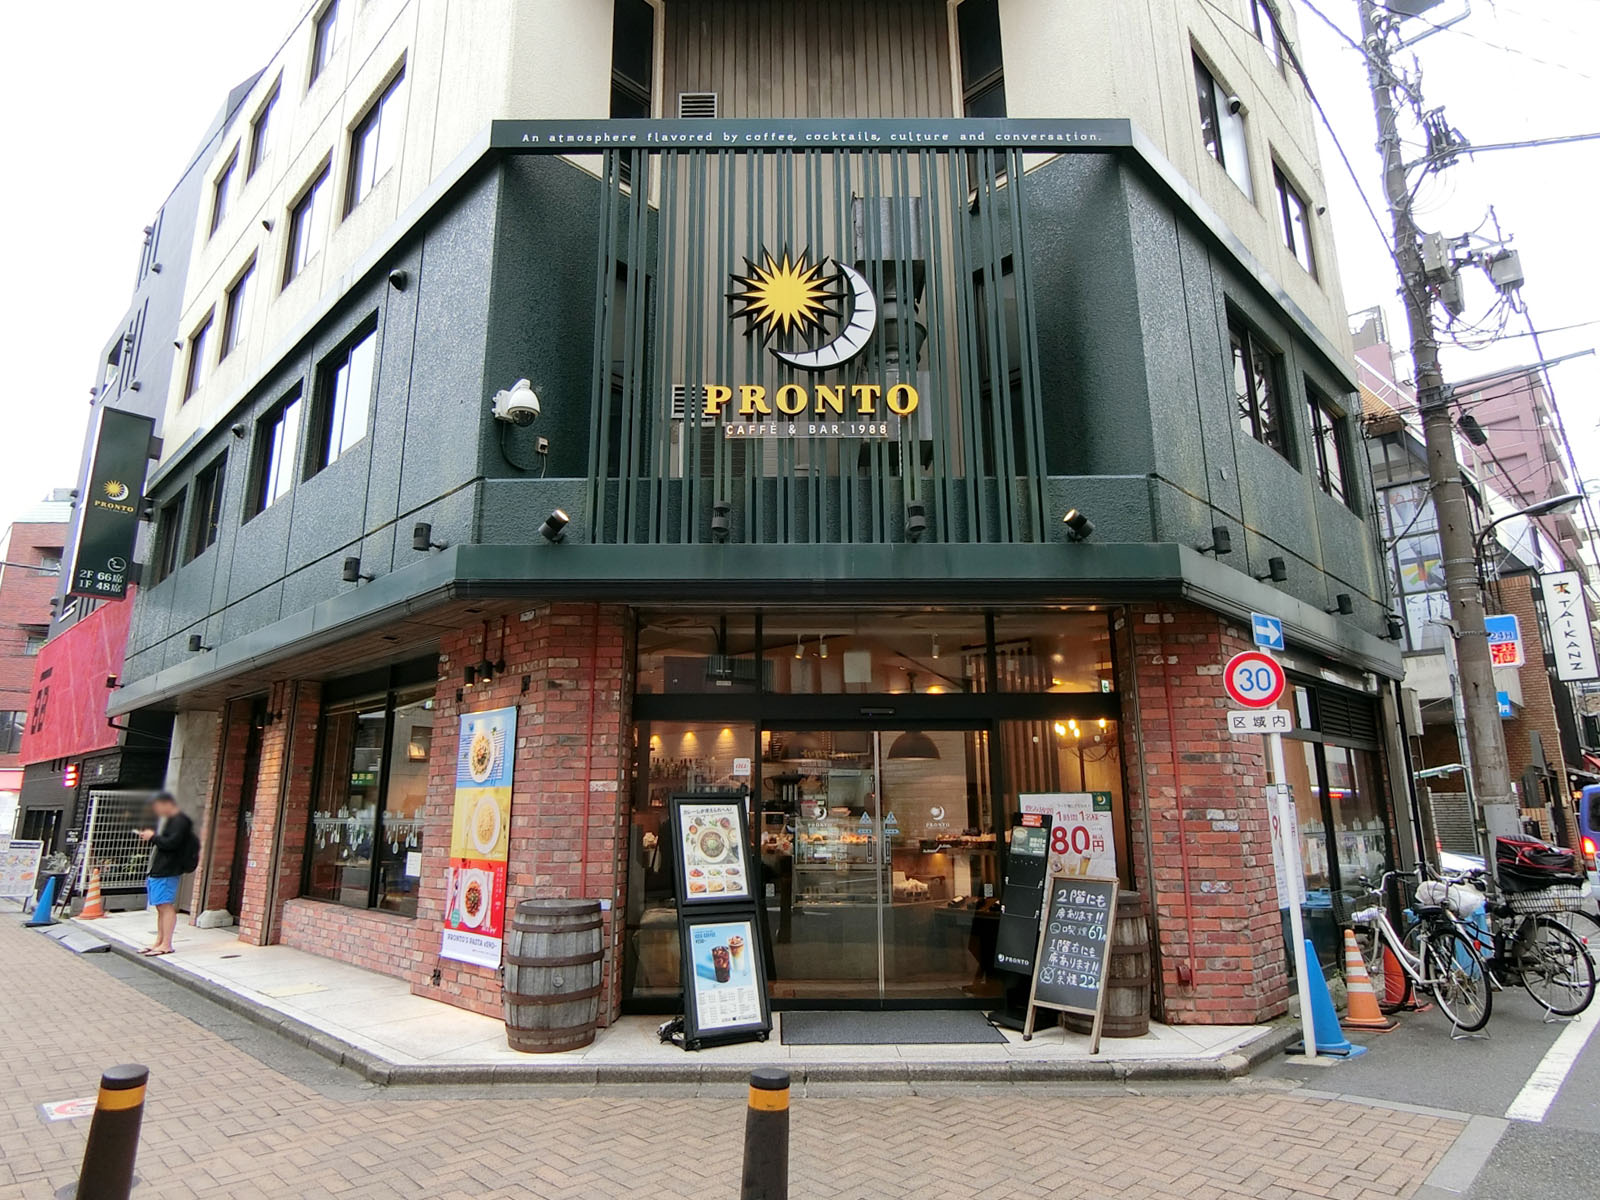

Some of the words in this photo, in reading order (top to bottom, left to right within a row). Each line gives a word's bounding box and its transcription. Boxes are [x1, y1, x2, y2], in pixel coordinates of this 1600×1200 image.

[522, 133, 540, 143] An
[549, 133, 637, 144] atmosphere
[647, 132, 713, 143] flavored
[723, 132, 738, 144] by
[745, 132, 798, 143] coffee,
[805, 131, 881, 142] cocktails,
[890, 131, 949, 142] culture
[960, 131, 985, 141] and
[995, 130, 1102, 142] conversation.
[703, 383, 919, 416] PRONTO
[788, 423, 797, 435] &
[809, 424, 840, 435] BAR
[850, 423, 888, 435] 1988
[94, 500, 134, 513] PRONTO
[79, 569, 95, 579] 2F
[79, 579, 93, 588] 1F
[1490, 631, 1513, 640] 24H
[1558, 599, 1584, 671] TAIKANZ
[1239, 667, 1272, 692] 30
[1233, 716, 1287, 728] 区域内
[1057, 889, 1106, 908] 2階にも
[1005, 956, 1030, 966] PRONTO
